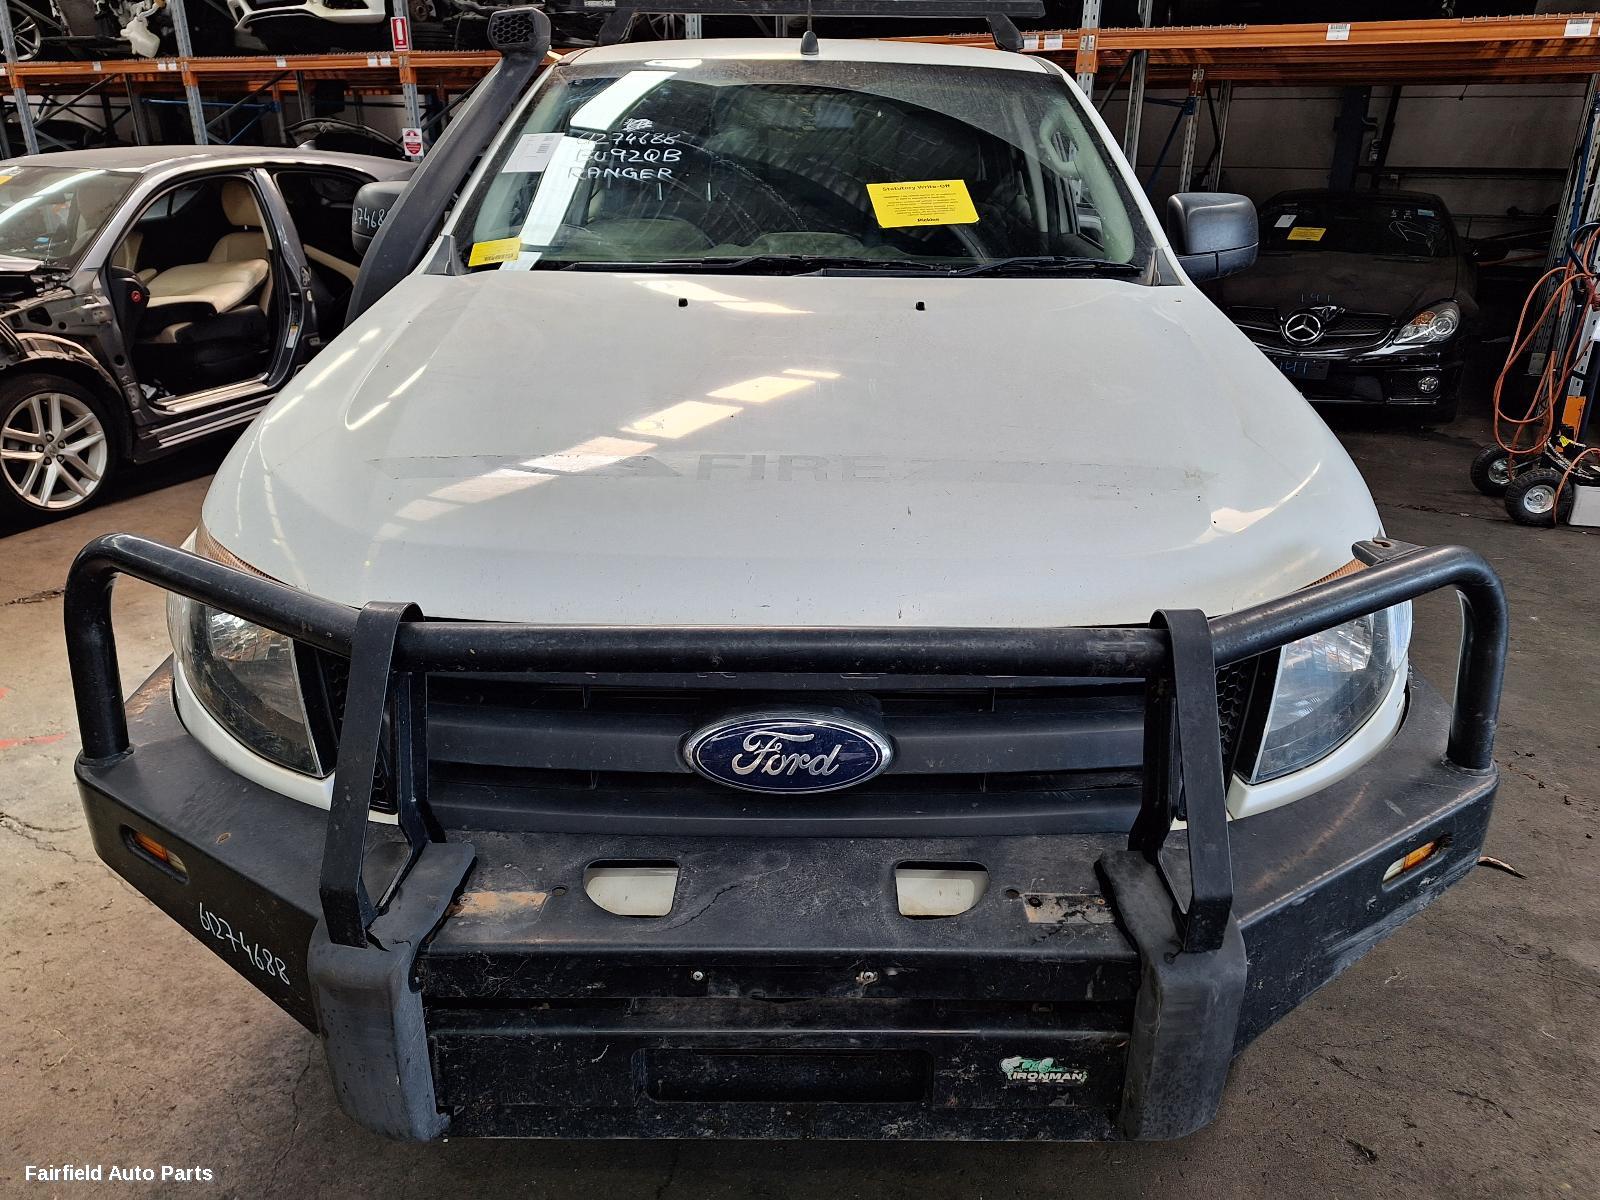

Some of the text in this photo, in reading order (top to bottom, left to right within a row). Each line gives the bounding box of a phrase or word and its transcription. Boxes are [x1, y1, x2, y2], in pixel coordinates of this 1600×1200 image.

[570, 166, 673, 180] RANGER
[731, 731, 842, 776] Ford
[1012, 1072, 1082, 1080] IRONMAN
